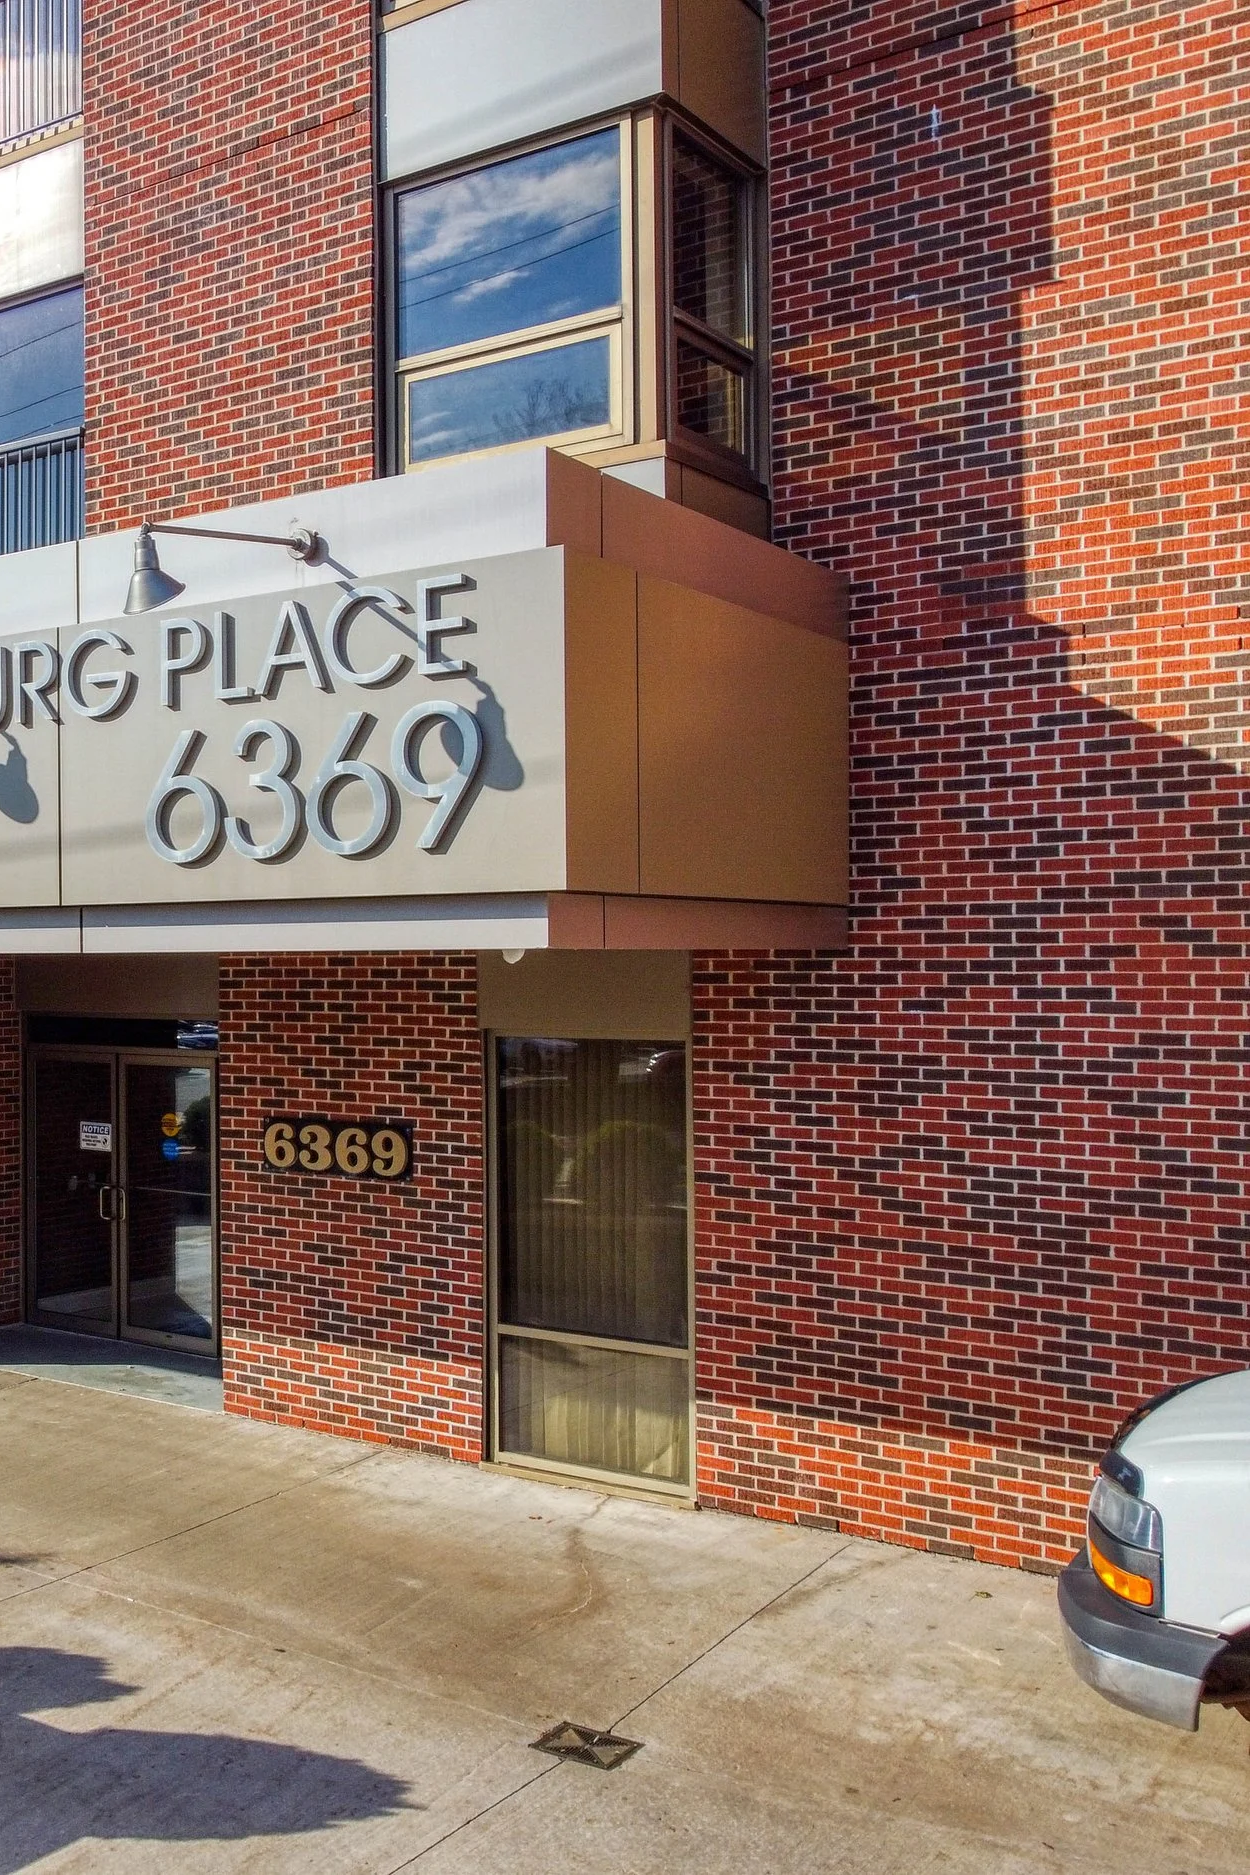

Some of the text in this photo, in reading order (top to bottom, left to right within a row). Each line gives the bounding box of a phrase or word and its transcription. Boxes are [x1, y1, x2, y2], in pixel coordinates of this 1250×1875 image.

[159, 573, 476, 711] PLACE
[146, 699, 485, 865] 6369
[82, 1125, 109, 1135] NOTICE
[264, 1122, 408, 1177] 6369
